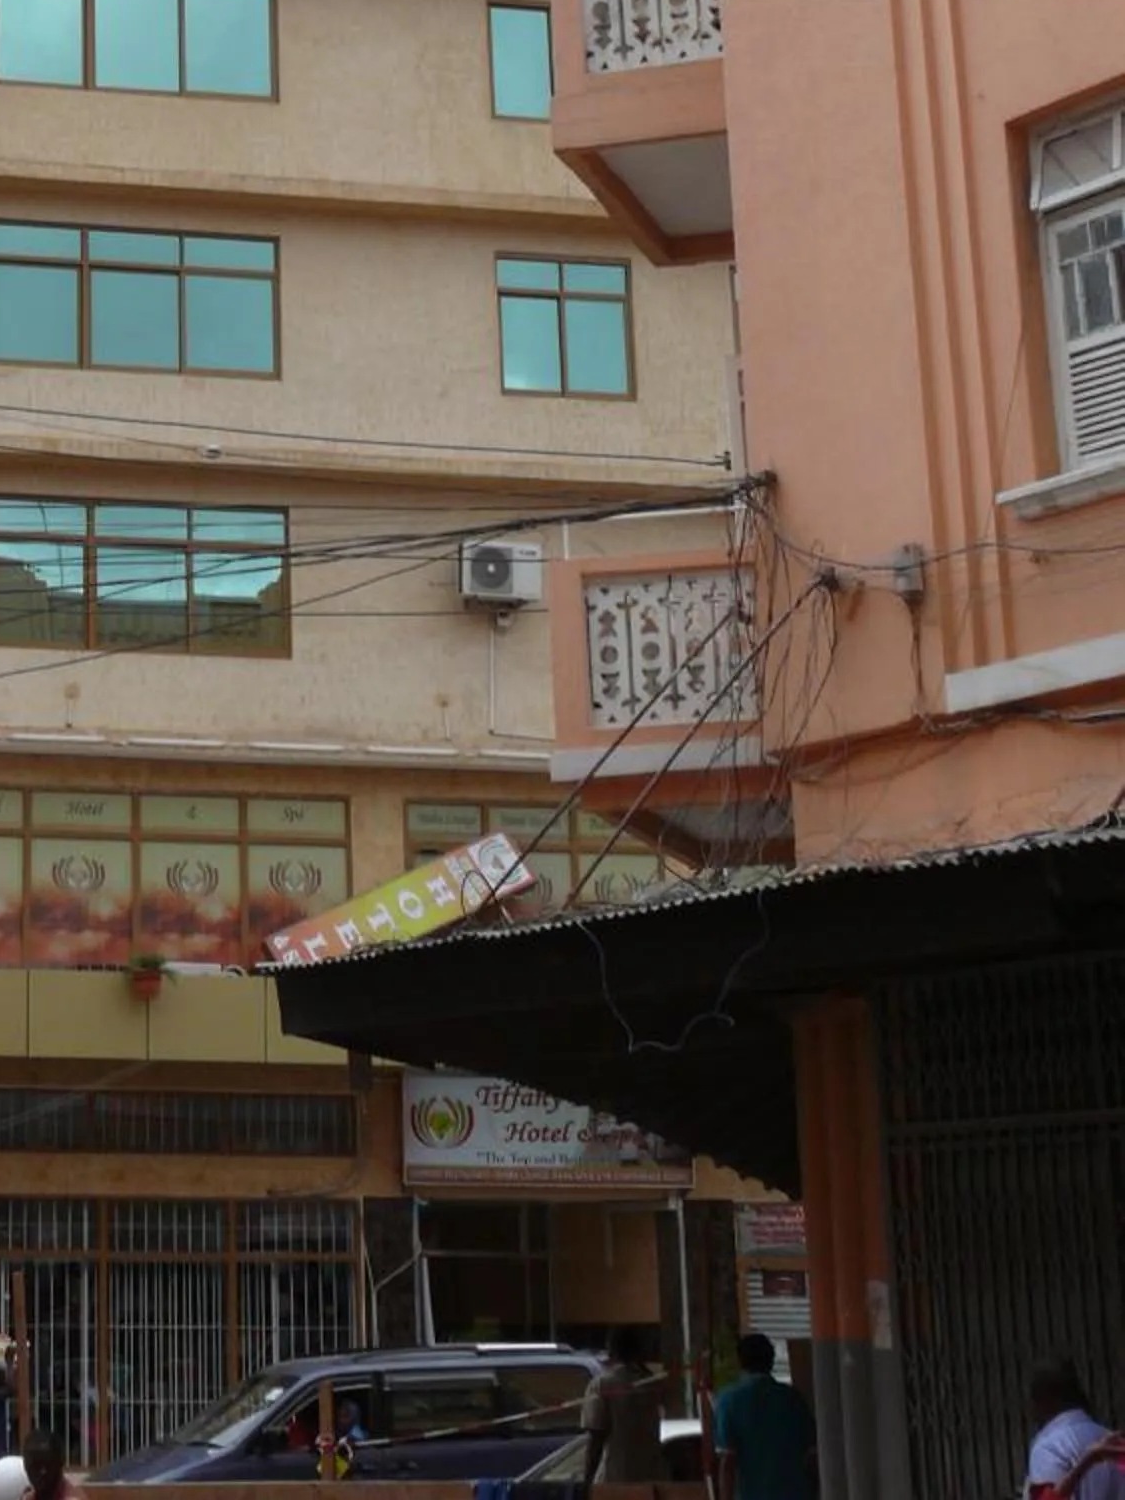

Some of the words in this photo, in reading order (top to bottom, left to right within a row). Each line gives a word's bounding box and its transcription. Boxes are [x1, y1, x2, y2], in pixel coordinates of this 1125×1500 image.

[303, 878, 456, 963] HOTEL
[475, 1084, 561, 1115] Tiffany
[504, 1120, 575, 1143] Hotel
